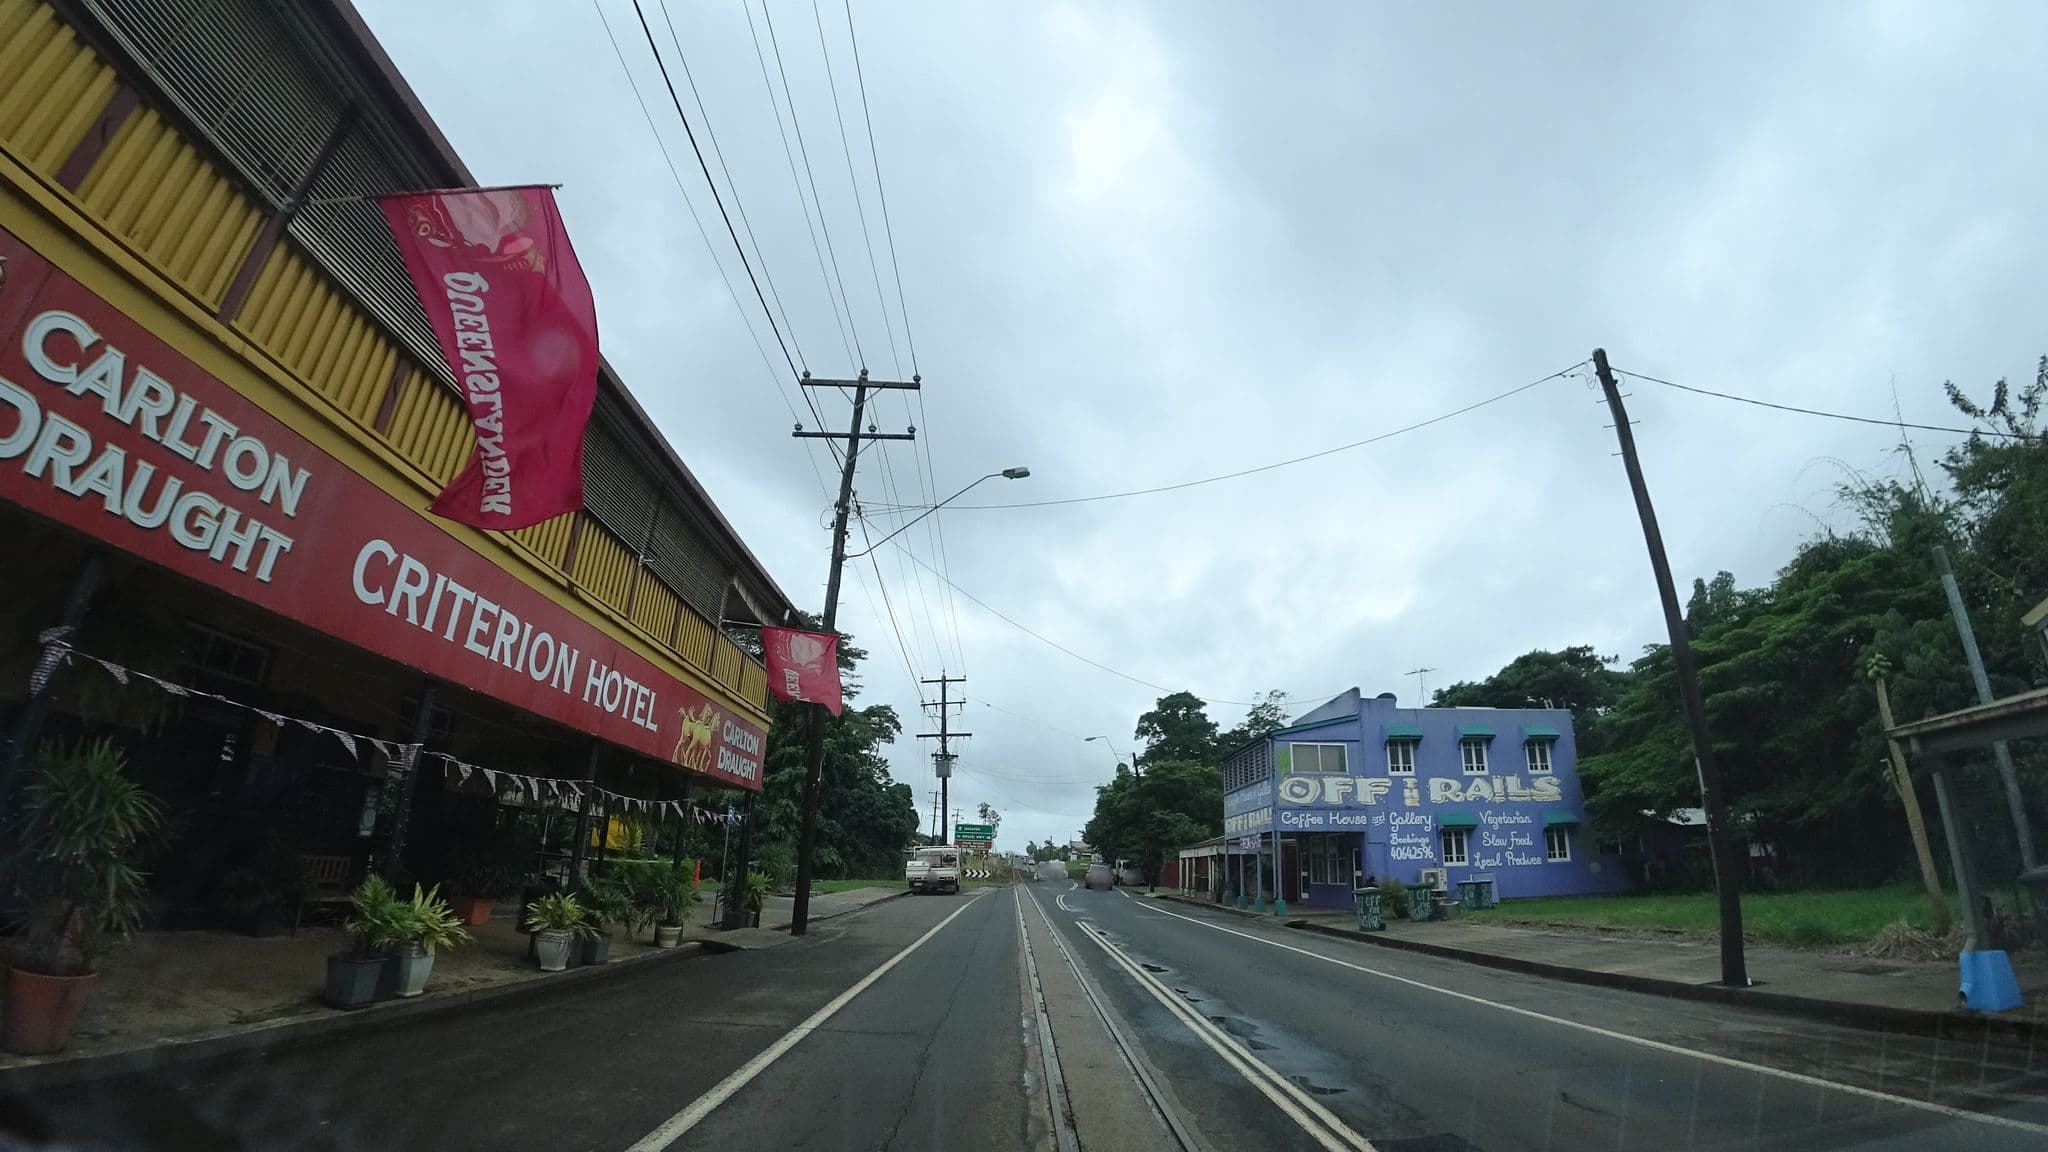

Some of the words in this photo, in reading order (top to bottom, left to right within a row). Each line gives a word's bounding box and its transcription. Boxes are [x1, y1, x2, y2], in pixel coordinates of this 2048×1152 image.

[22, 309, 312, 518] CARLTON
[0, 377, 293, 584] DRAUGHT
[352, 539, 580, 694] CRITERION
[582, 658, 660, 733] HOTEL
[723, 720, 760, 756] CARLTON
[717, 746, 757, 781] DRAUGHT
[1279, 776, 1392, 805] OFF
[1428, 774, 1562, 804] RAILS
[1281, 811, 1324, 828] Coffee
[1329, 812, 1367, 825] House
[1372, 812, 1386, 826] and
[1389, 812, 1432, 832] Gallery
[1479, 810, 1532, 830] Vegetarian
[1390, 833, 1430, 847] Bookings
[1482, 831, 1507, 847] Slow
[1510, 831, 1533, 850] Food
[1473, 851, 1503, 870] Local
[1505, 851, 1542, 867] Produce
